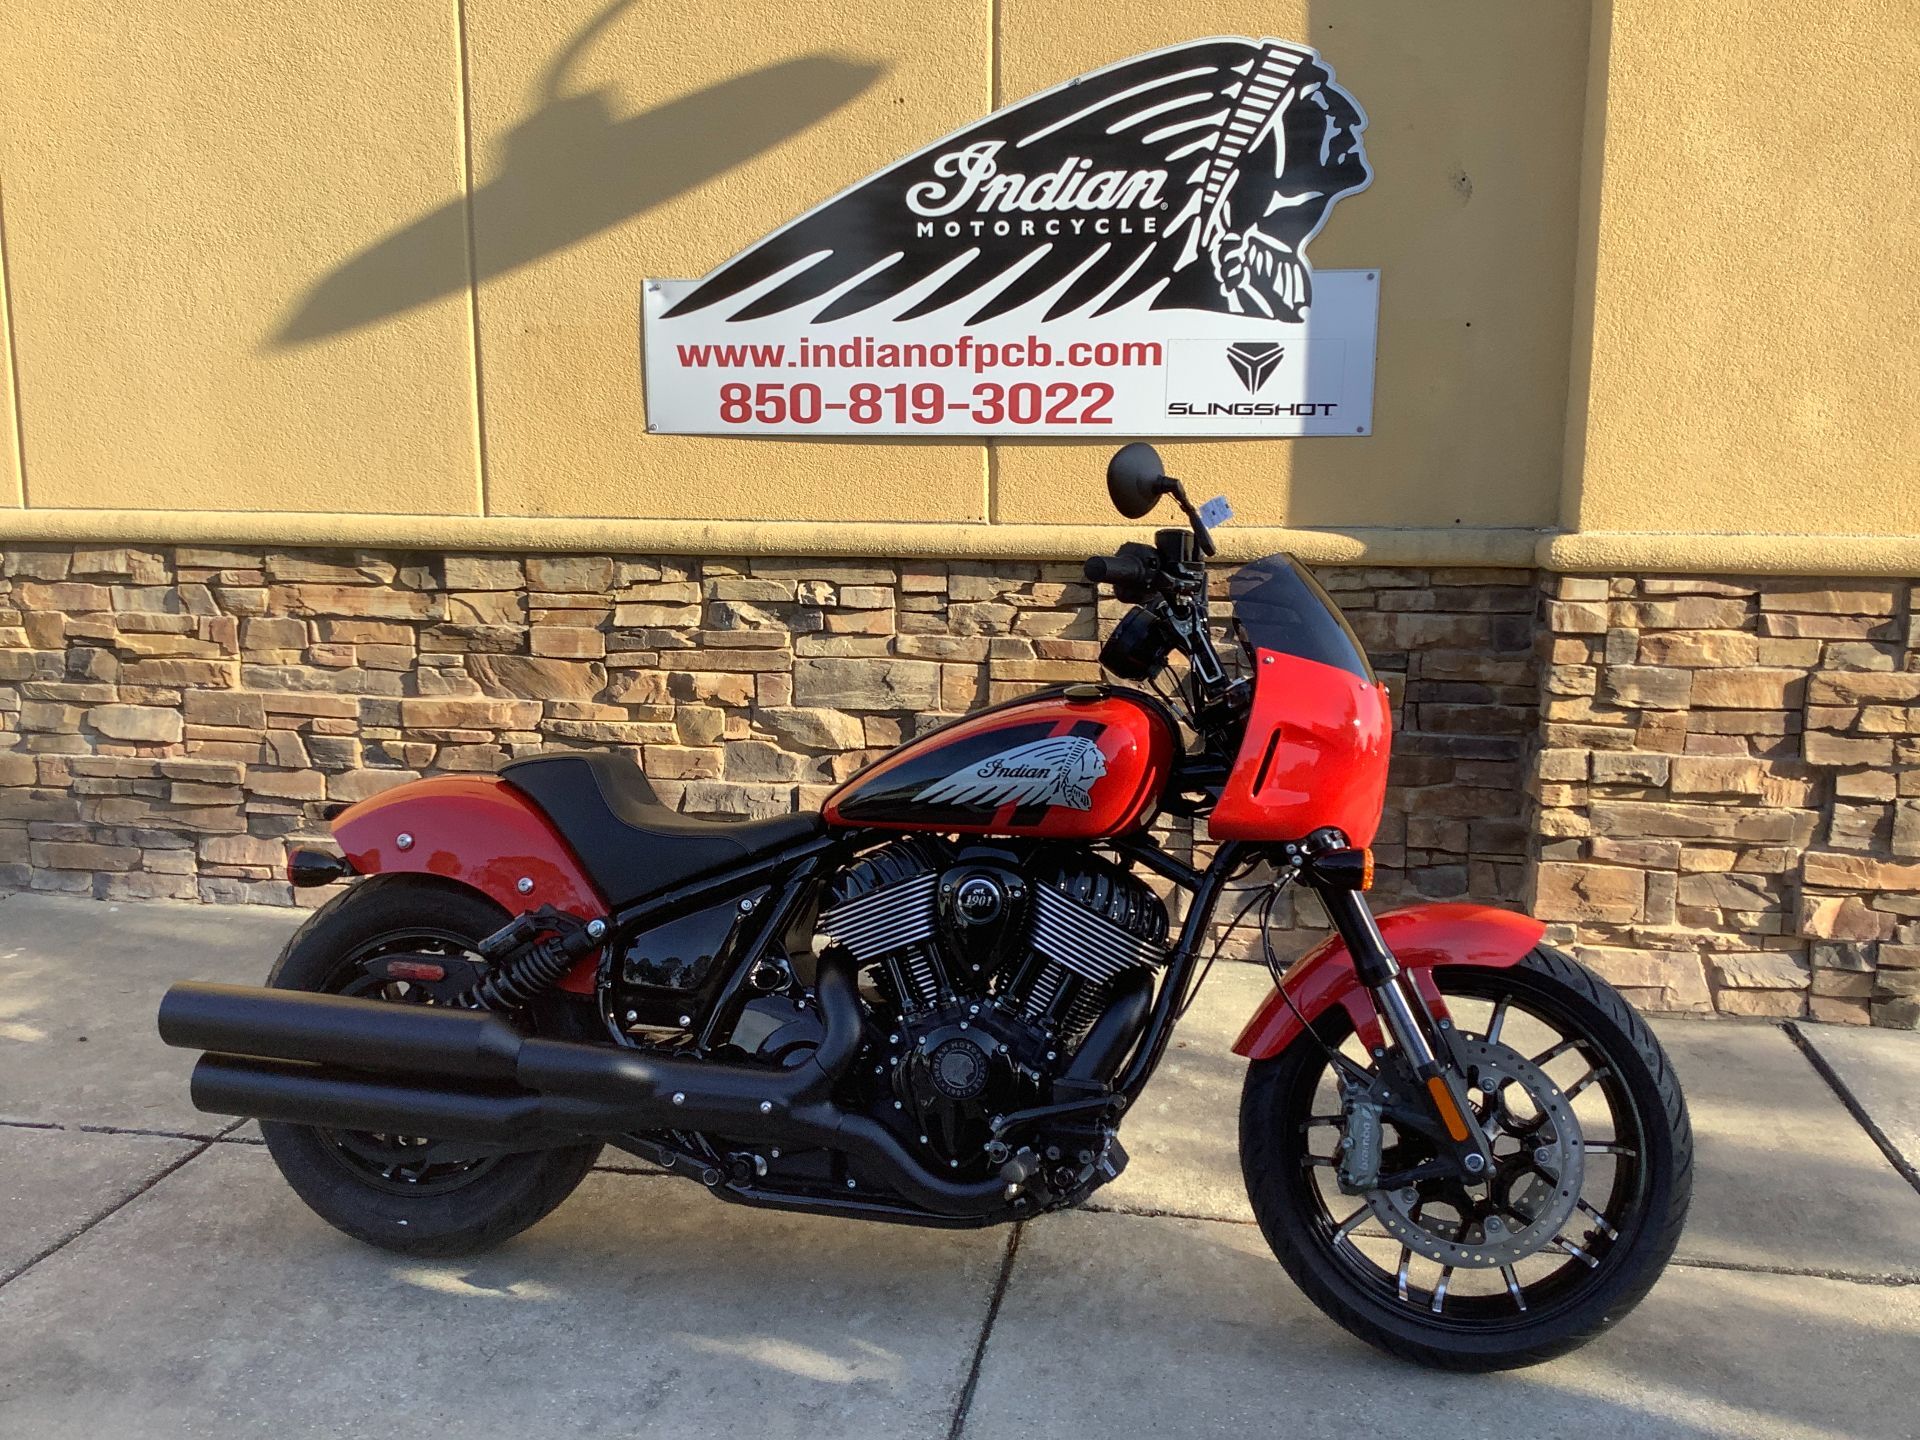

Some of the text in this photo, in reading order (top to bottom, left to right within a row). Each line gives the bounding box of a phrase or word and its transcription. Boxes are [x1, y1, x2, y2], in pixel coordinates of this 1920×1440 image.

[906, 140, 1168, 217] Indian
[916, 217, 1157, 238] MOTORCYCLE
[676, 335, 1163, 373] www.indianofpcb.com
[719, 382, 1115, 425] 850-819-3022
[1167, 402, 1338, 417] SLINGSHOT
[977, 758, 1051, 778] Indian
[964, 895, 992, 908] 1901
